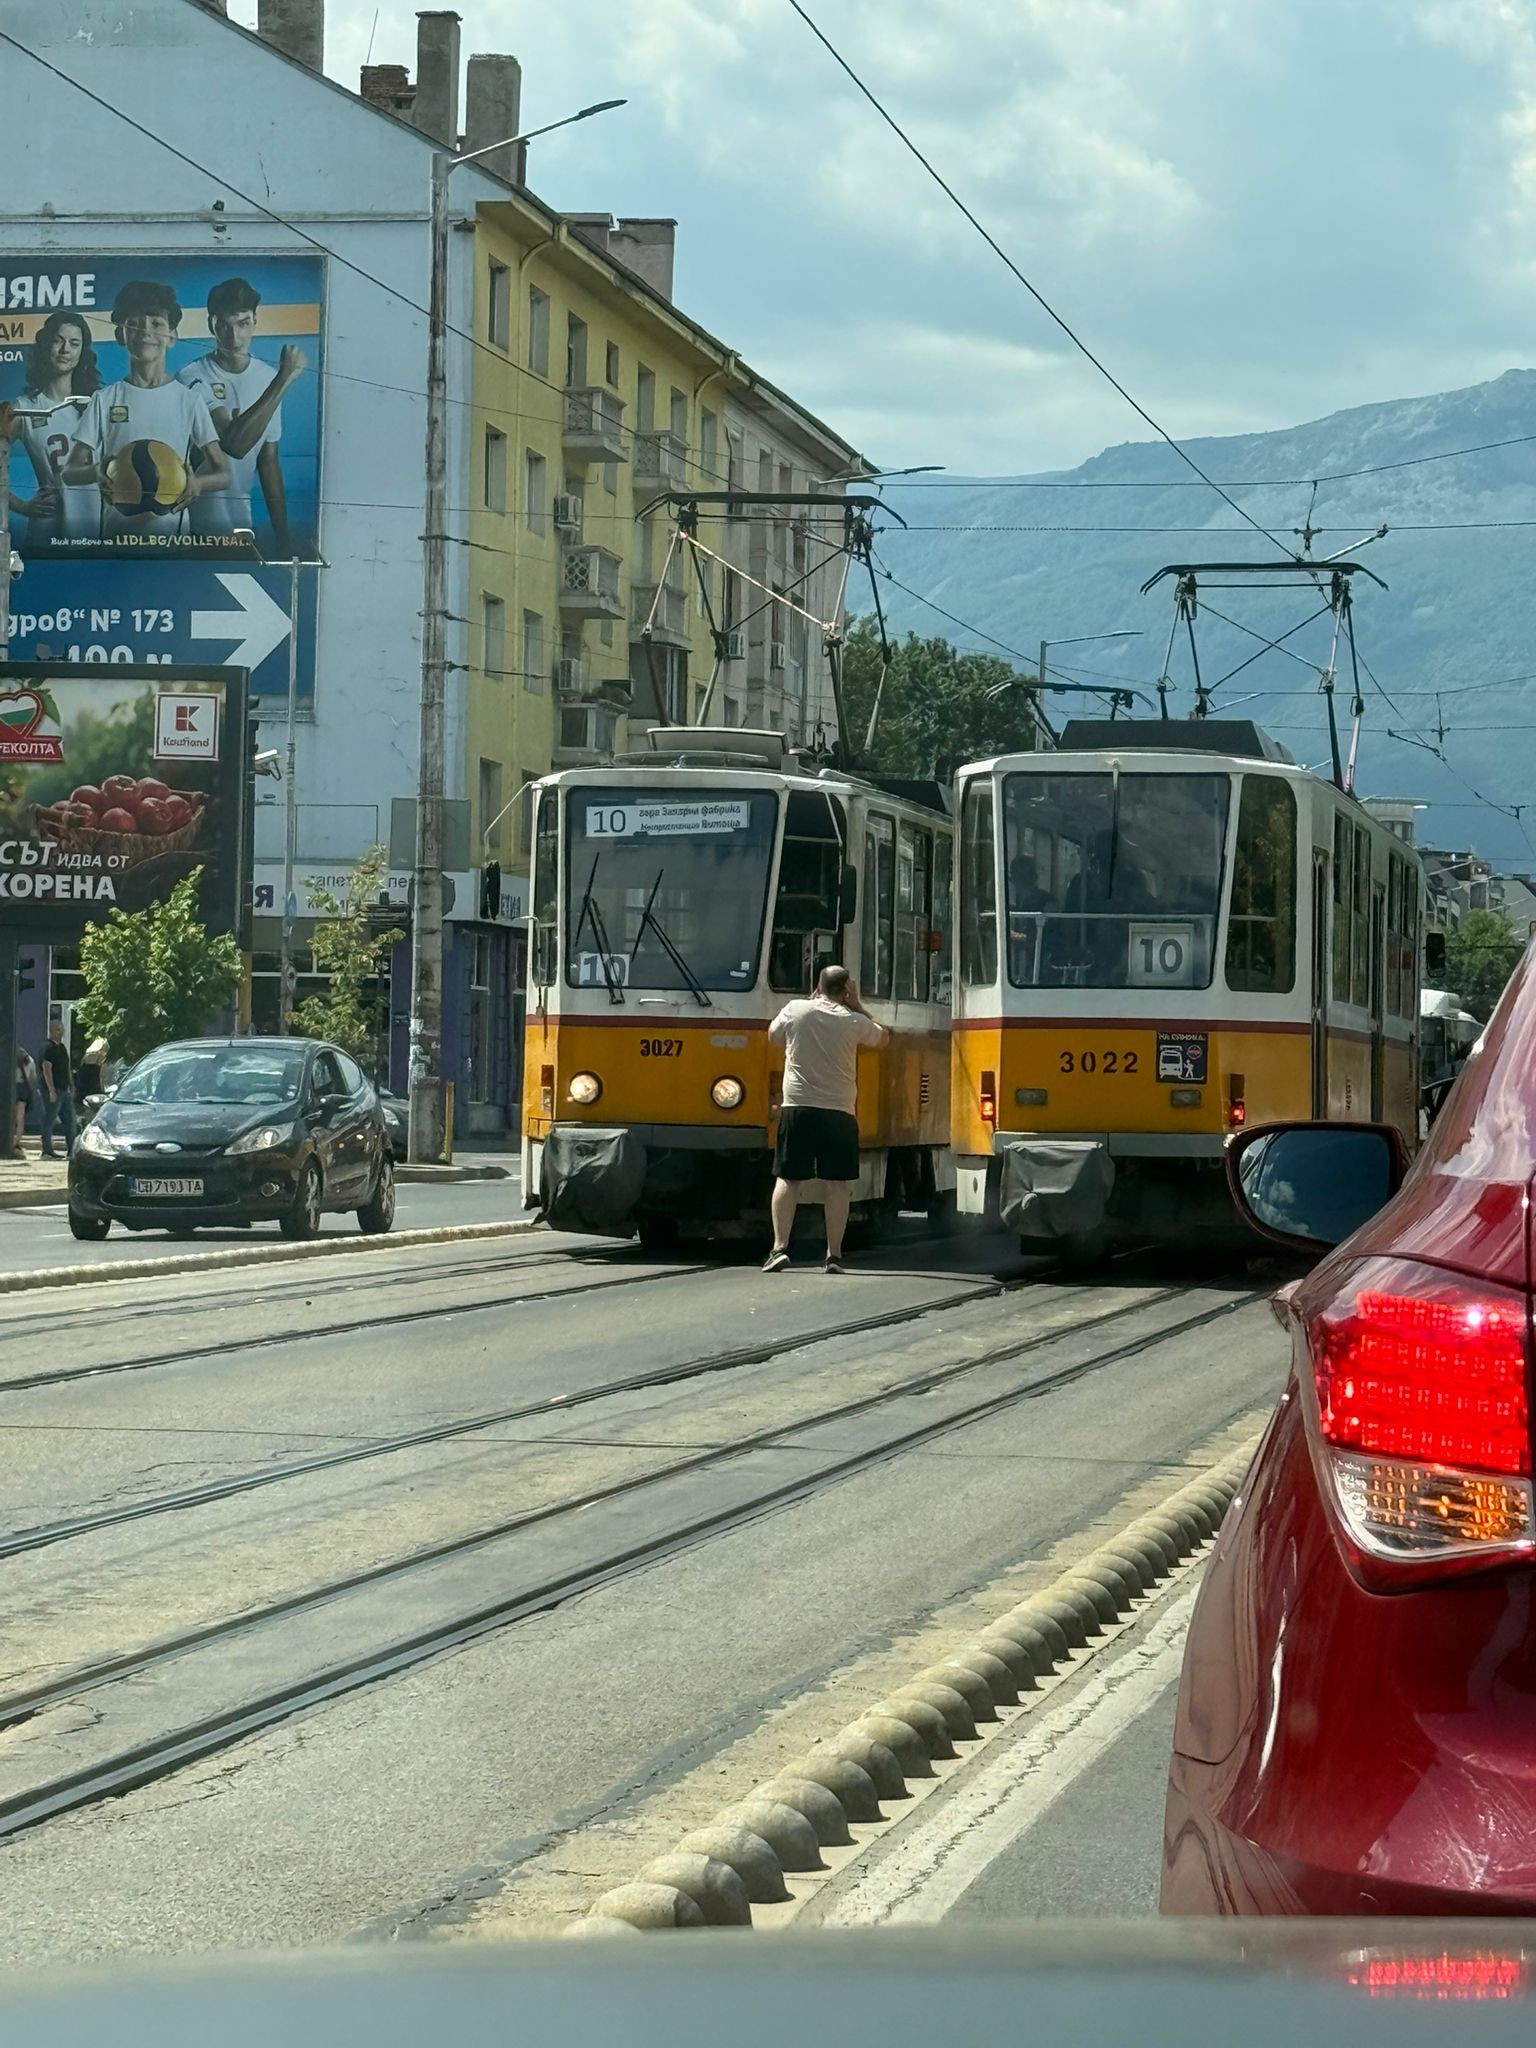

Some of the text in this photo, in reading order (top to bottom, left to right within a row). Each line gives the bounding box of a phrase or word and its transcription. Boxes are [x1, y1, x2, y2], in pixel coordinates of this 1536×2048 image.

[0, 274, 96, 308] ЯМЕ
[131, 609, 174, 632] 173
[593, 809, 626, 833] 10
[56, 853, 102, 869] ИДВА
[107, 855, 130, 868] ОТ
[1140, 938, 1183, 973] 10
[583, 955, 626, 985] 10
[640, 1039, 683, 1057] 3027
[1060, 1051, 1138, 1074] 3022
